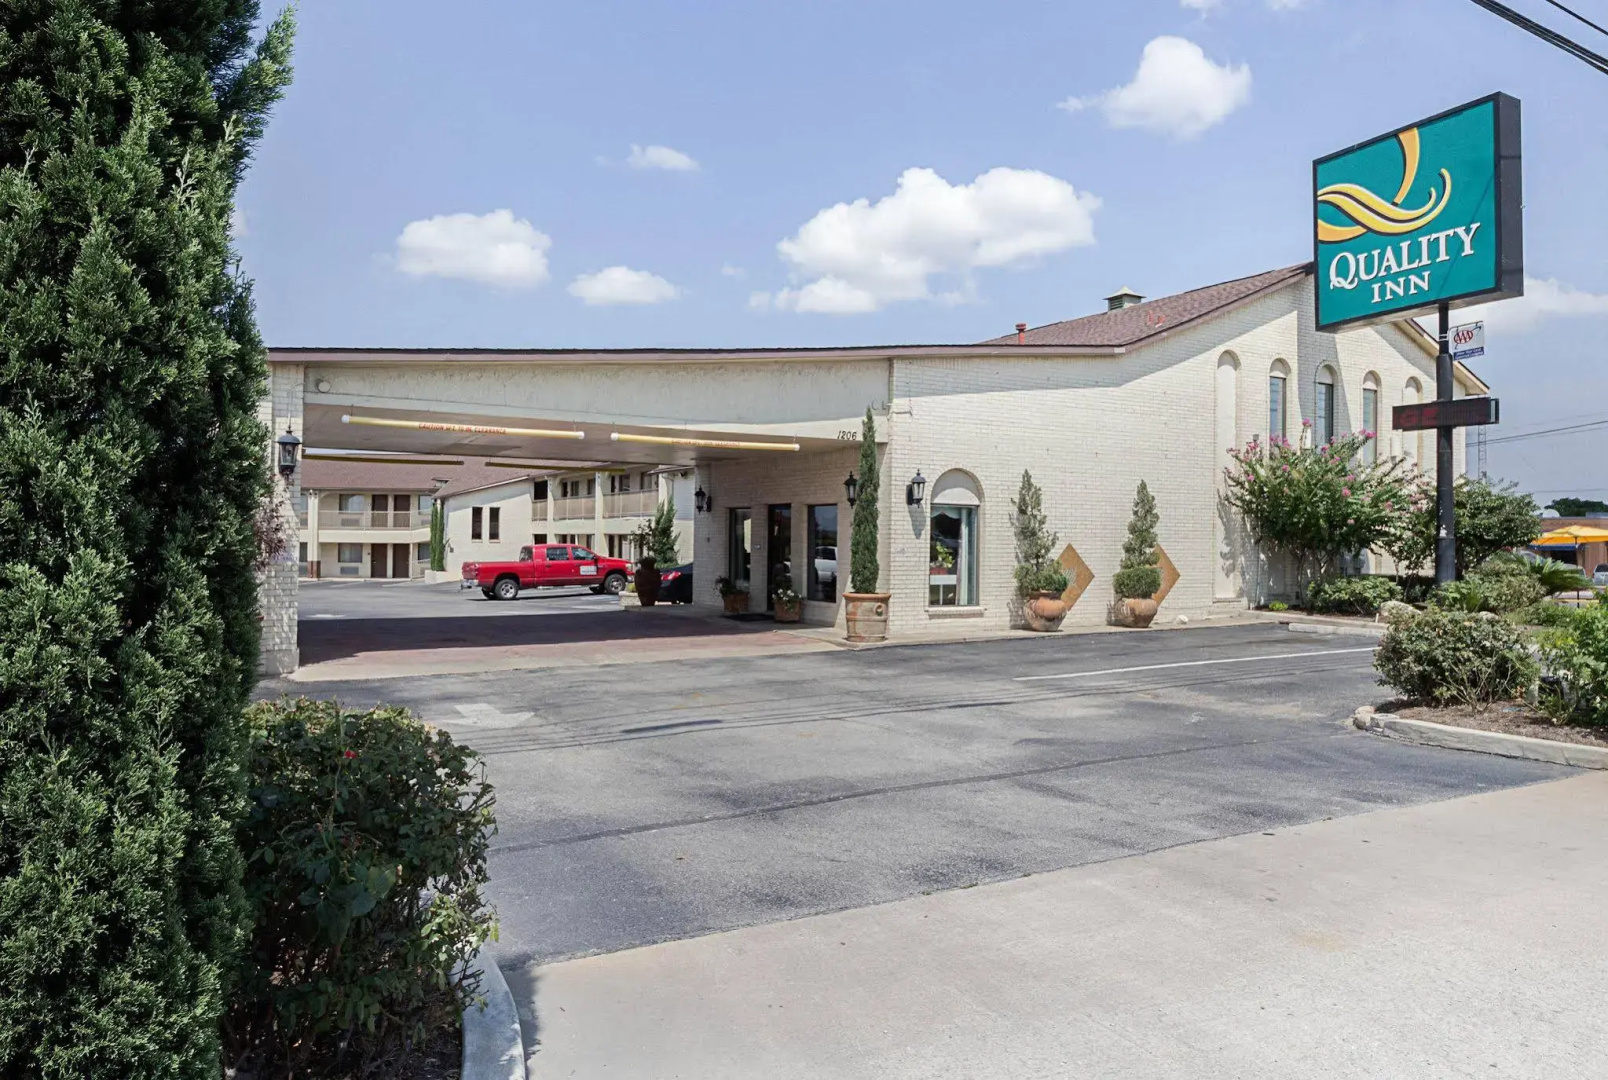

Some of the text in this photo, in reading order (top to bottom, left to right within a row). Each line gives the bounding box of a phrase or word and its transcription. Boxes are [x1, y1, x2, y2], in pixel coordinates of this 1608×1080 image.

[1330, 222, 1480, 290] QUALITY
[1371, 271, 1430, 303] INN
[1454, 330, 1473, 344] AAA
[419, 422, 444, 431] CAUTION
[474, 426, 506, 434] CLEARANCE
[837, 430, 857, 440] 1206
